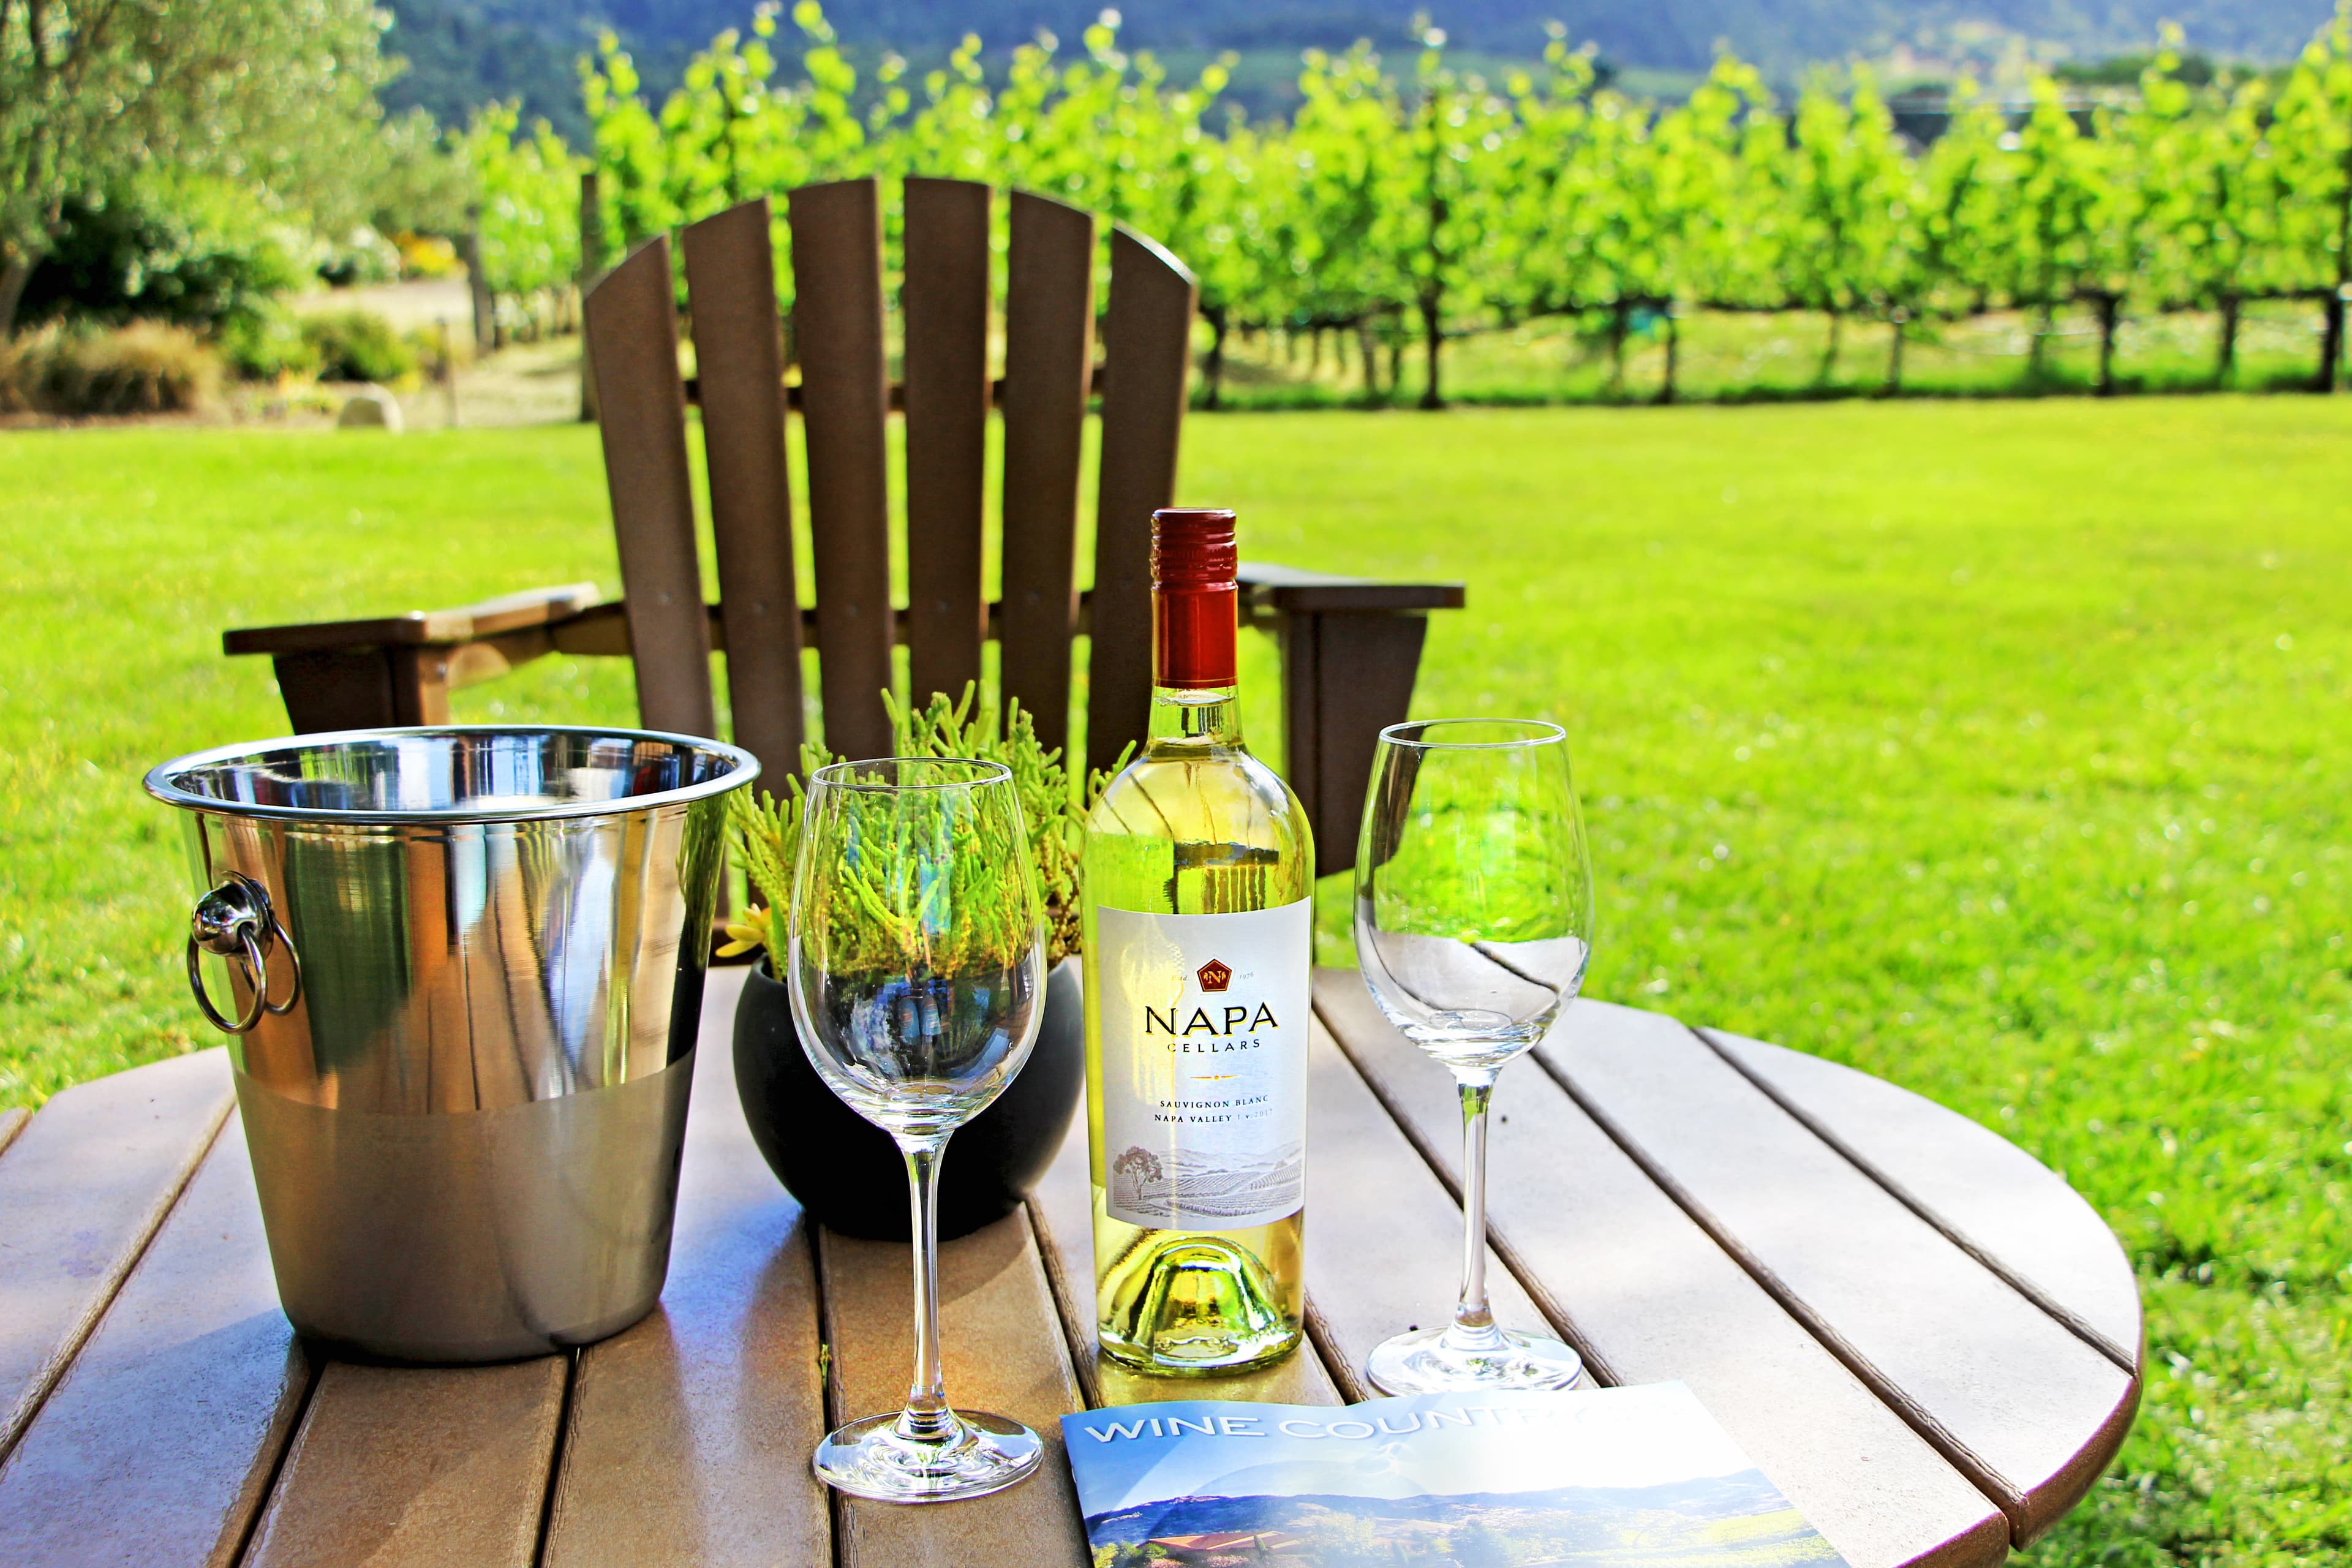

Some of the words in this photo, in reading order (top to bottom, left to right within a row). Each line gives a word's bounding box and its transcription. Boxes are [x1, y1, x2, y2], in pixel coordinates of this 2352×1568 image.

[1145, 1003, 1279, 1037] NAPA
[1168, 1039, 1261, 1052] CELLARS
[1236, 1095, 1268, 1106] BLANC
[1084, 1415, 1266, 1443] WINE
[1279, 1407, 1588, 1439] COUNTRY
